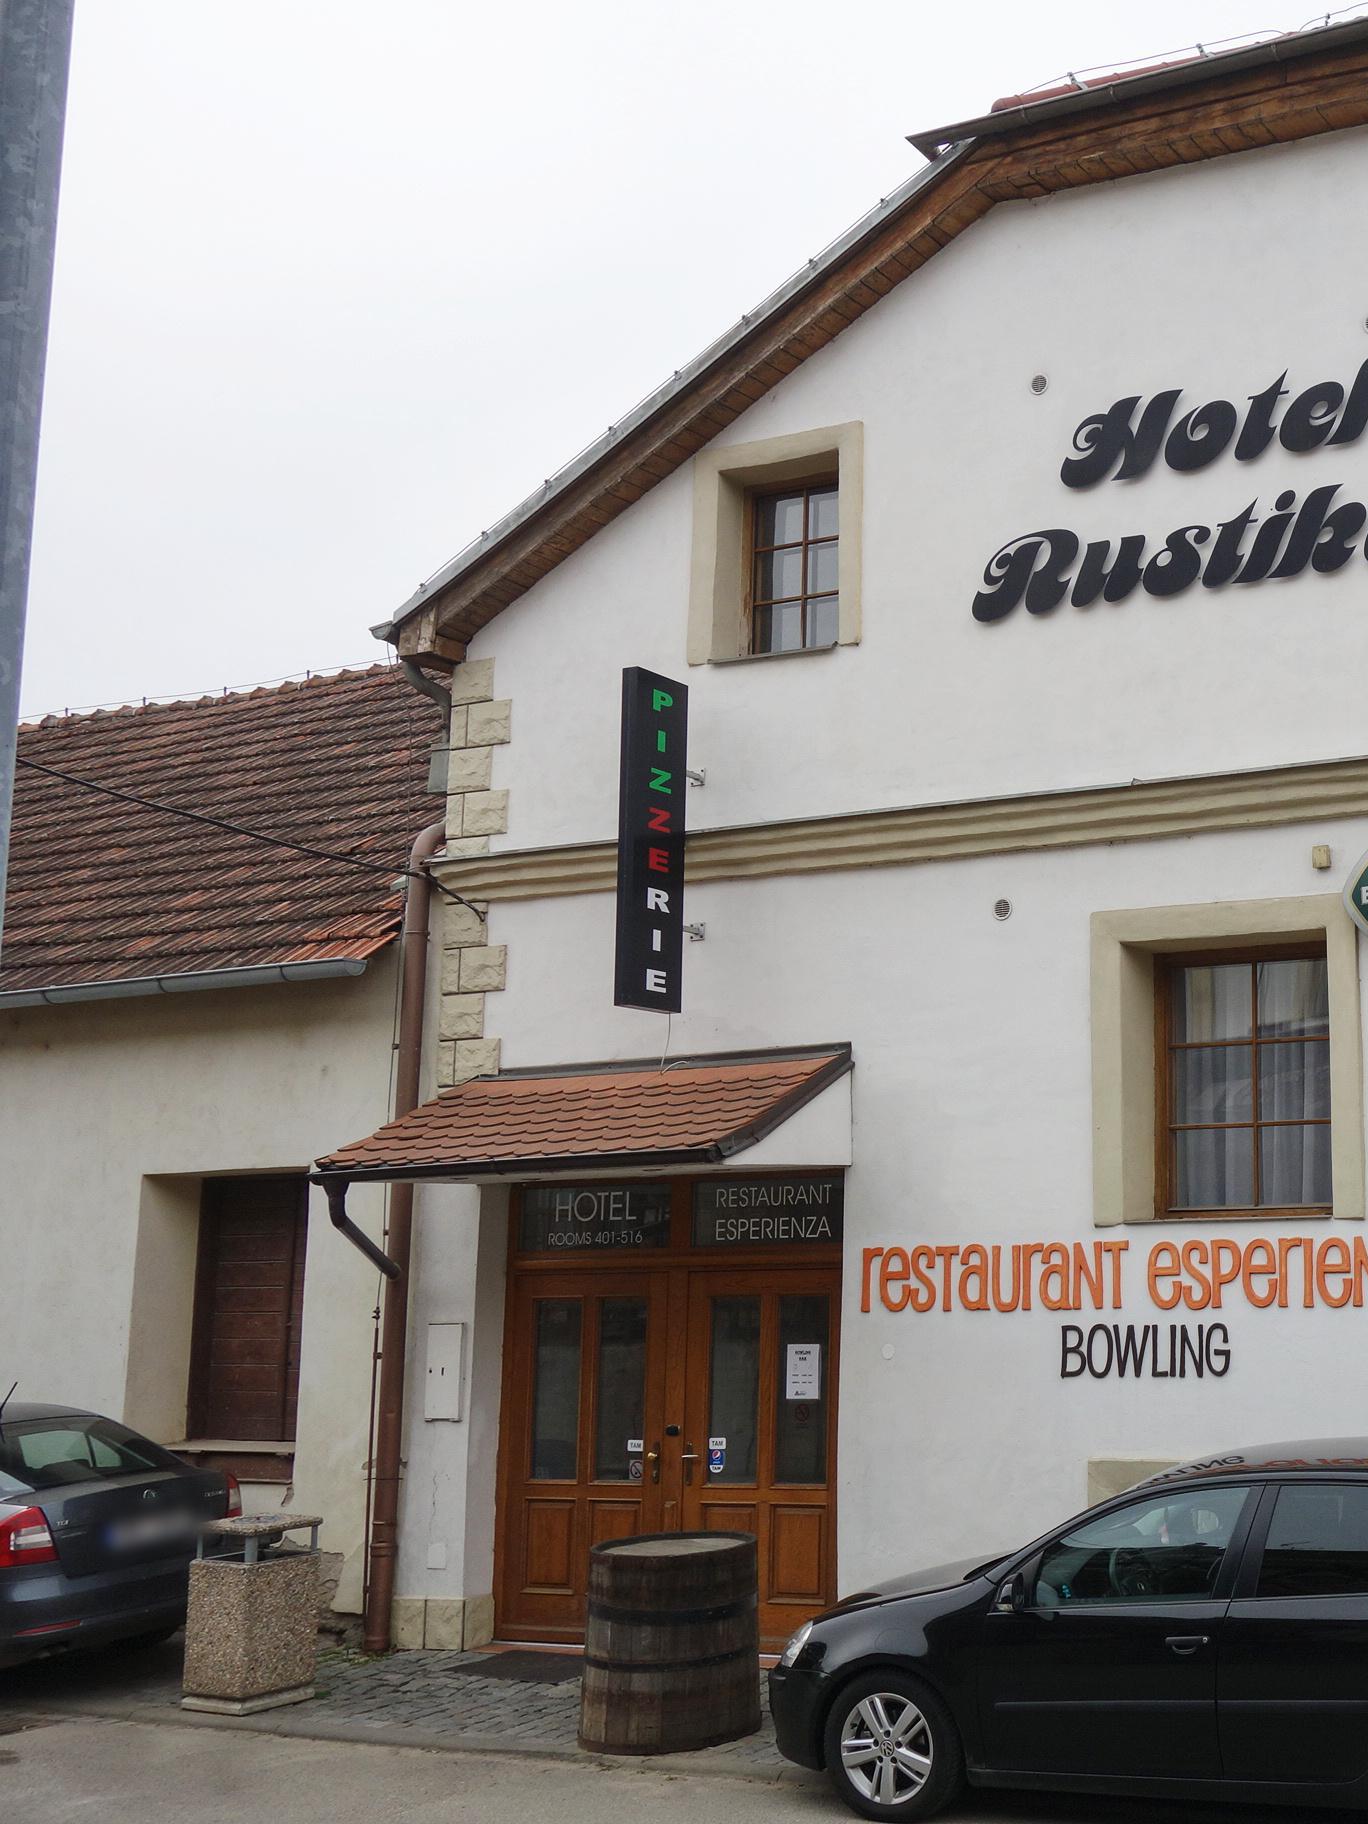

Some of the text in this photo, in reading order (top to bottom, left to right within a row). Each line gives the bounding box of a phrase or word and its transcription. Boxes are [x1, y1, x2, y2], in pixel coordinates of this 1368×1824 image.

[645, 688, 674, 994] PIZZERIE
[555, 1191, 637, 1222] HOTEL
[715, 1184, 832, 1208] RESTAURANT
[548, 1230, 643, 1246] ROOMS 401-516
[715, 1216, 832, 1241] ESPERIENZA
[1061, 1323, 1231, 1378] BOWLING
